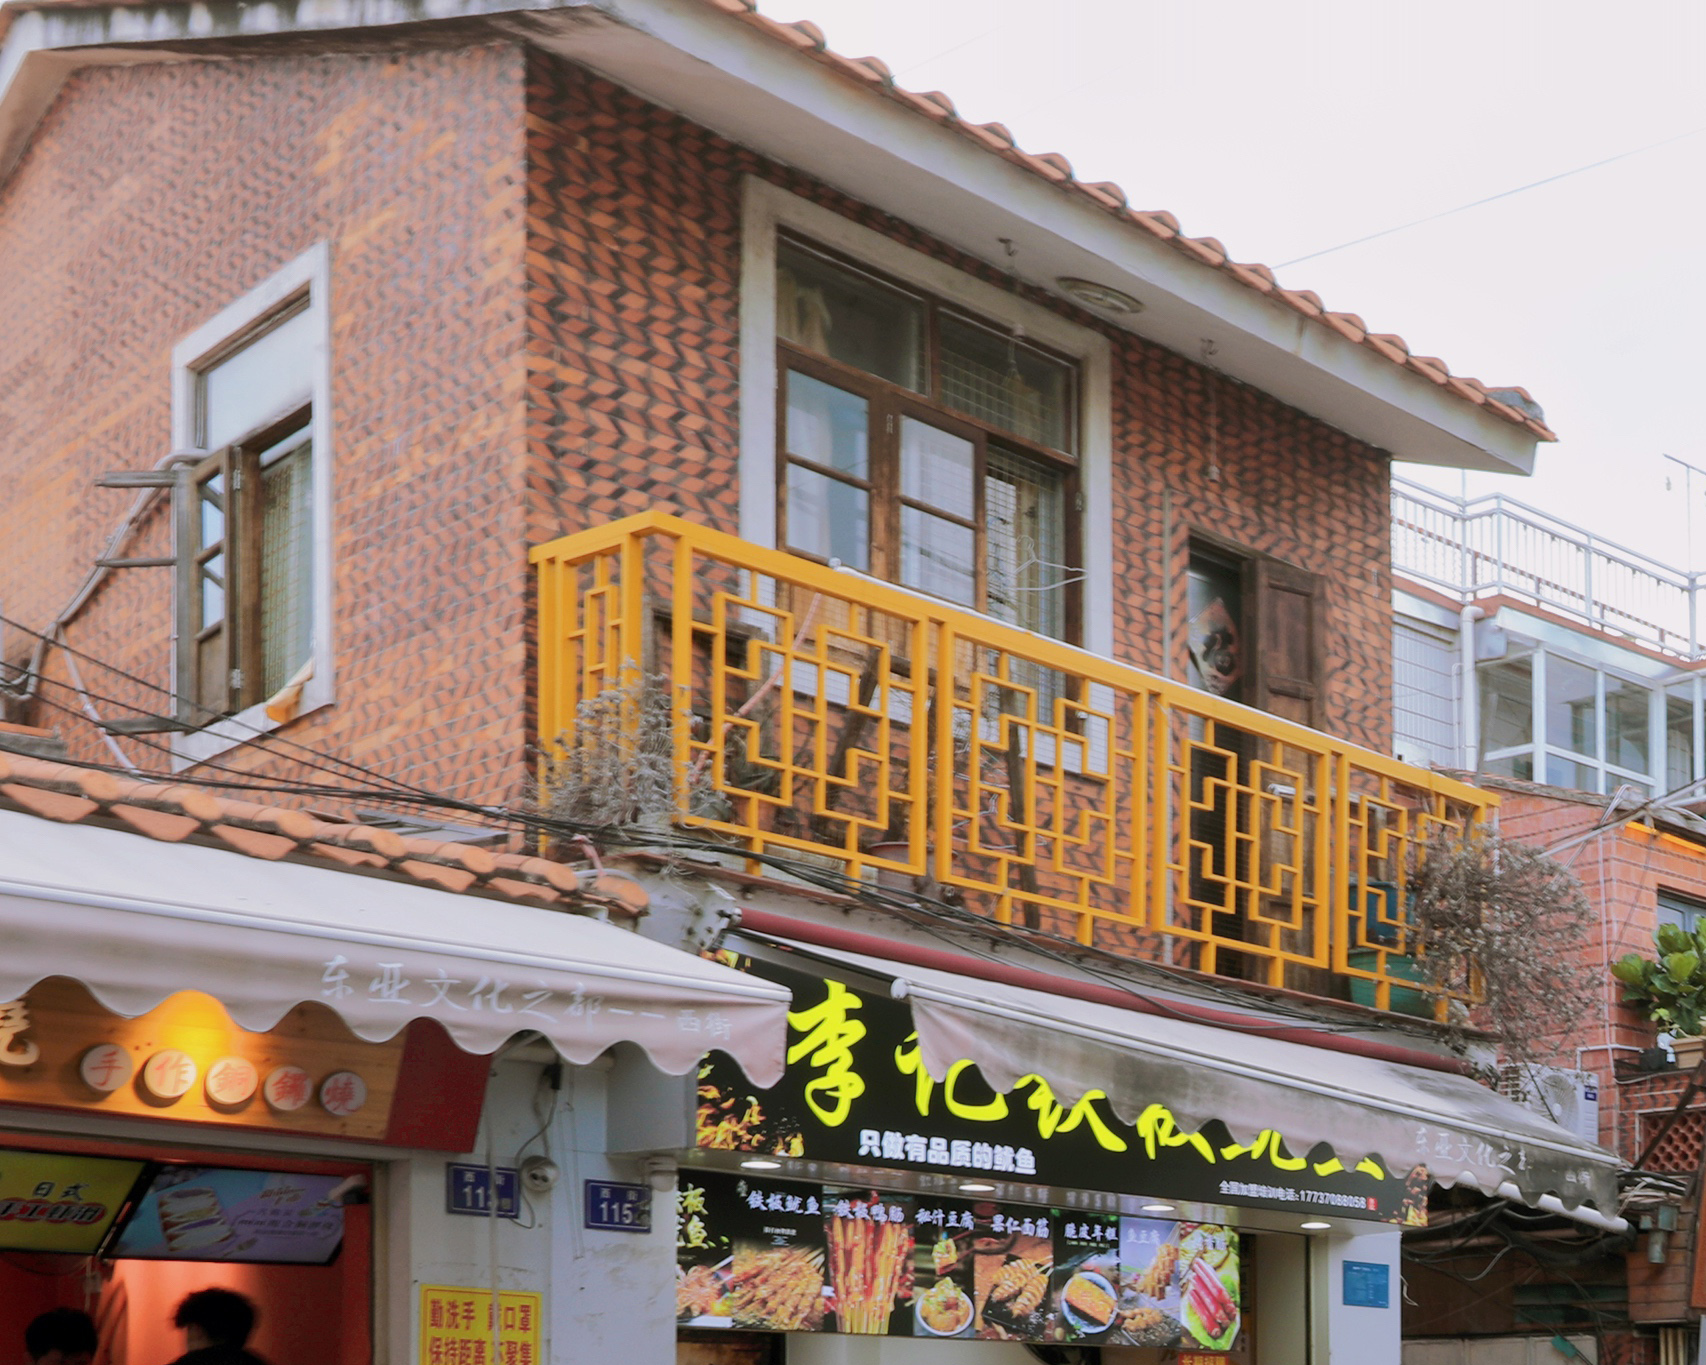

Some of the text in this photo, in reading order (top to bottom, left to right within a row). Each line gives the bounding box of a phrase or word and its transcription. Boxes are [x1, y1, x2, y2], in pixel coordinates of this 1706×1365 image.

[858, 1128, 1036, 1175] 只做有品质的鱿鱼
[746, 1190, 821, 1216] 铁板鱿鱼
[834, 1199, 904, 1224] 铁板鸭肠
[915, 1208, 974, 1230] 秘汁豆腐
[990, 1213, 1049, 1239] 果仁面筋
[1064, 1222, 1118, 1242] 脆皮年糕
[430, 1299, 475, 1331] 勤洗手
